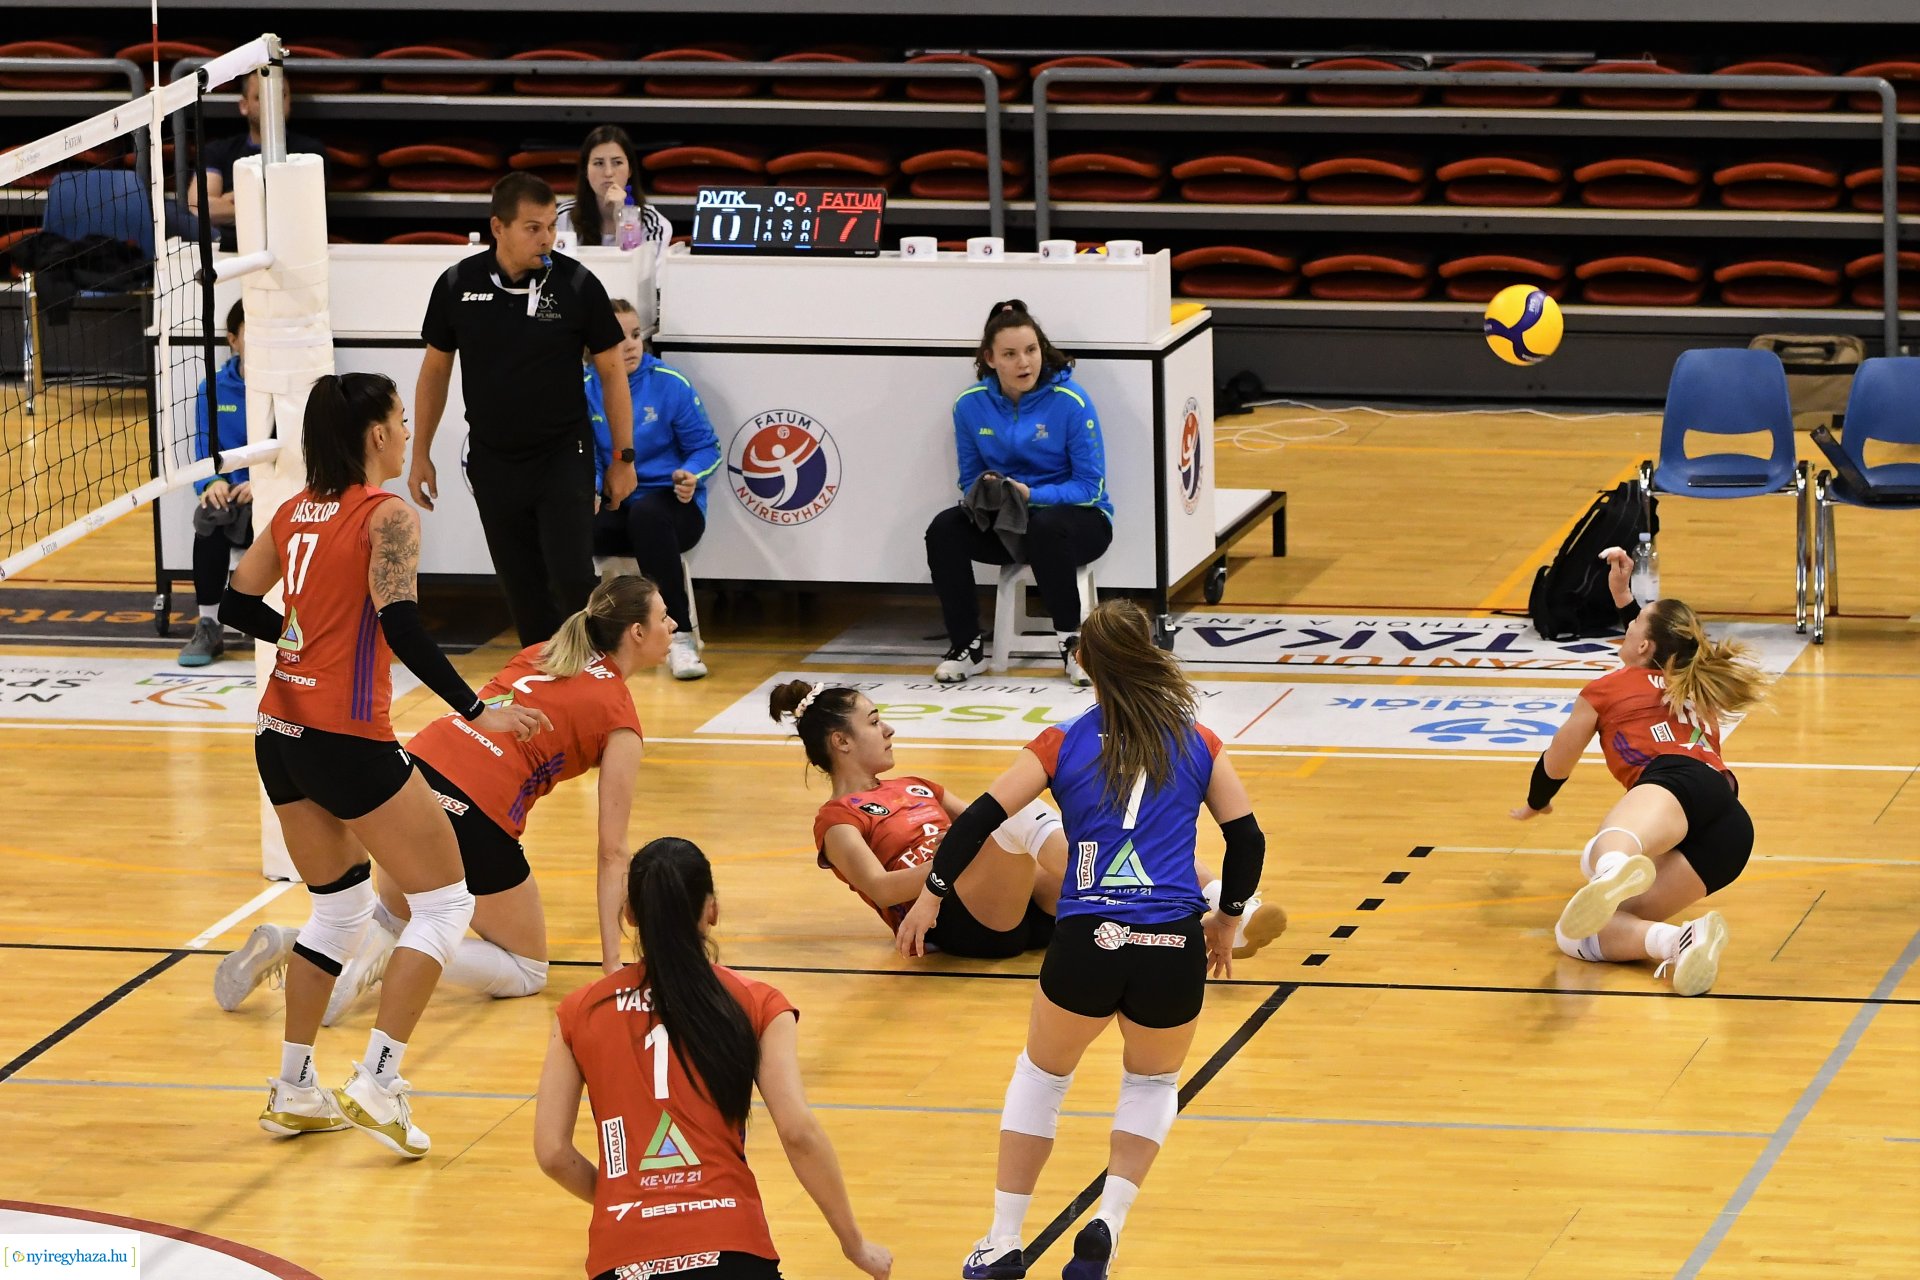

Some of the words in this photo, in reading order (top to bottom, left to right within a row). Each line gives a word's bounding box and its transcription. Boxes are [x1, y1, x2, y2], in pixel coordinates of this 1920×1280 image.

[699, 191, 746, 205] DVTK
[822, 192, 882, 208] FATUM
[837, 209, 863, 243] 7
[461, 291, 494, 302] Zeus
[754, 411, 812, 430] FATUM
[287, 532, 320, 595] 17
[274, 669, 317, 687] BESTRONG
[267, 716, 304, 738] REVESZ
[452, 717, 504, 757] BESTRONG
[1081, 843, 1094, 888] STRABAG
[1127, 931, 1187, 948] REVESZ
[644, 1023, 670, 1100] 1
[612, 1120, 622, 1174] STRABAG
[640, 1172, 685, 1186] KE-VIZ
[687, 1169, 702, 1183] 21
[641, 1197, 737, 1219] BESTRONG
[651, 1250, 720, 1276] REVESZ
